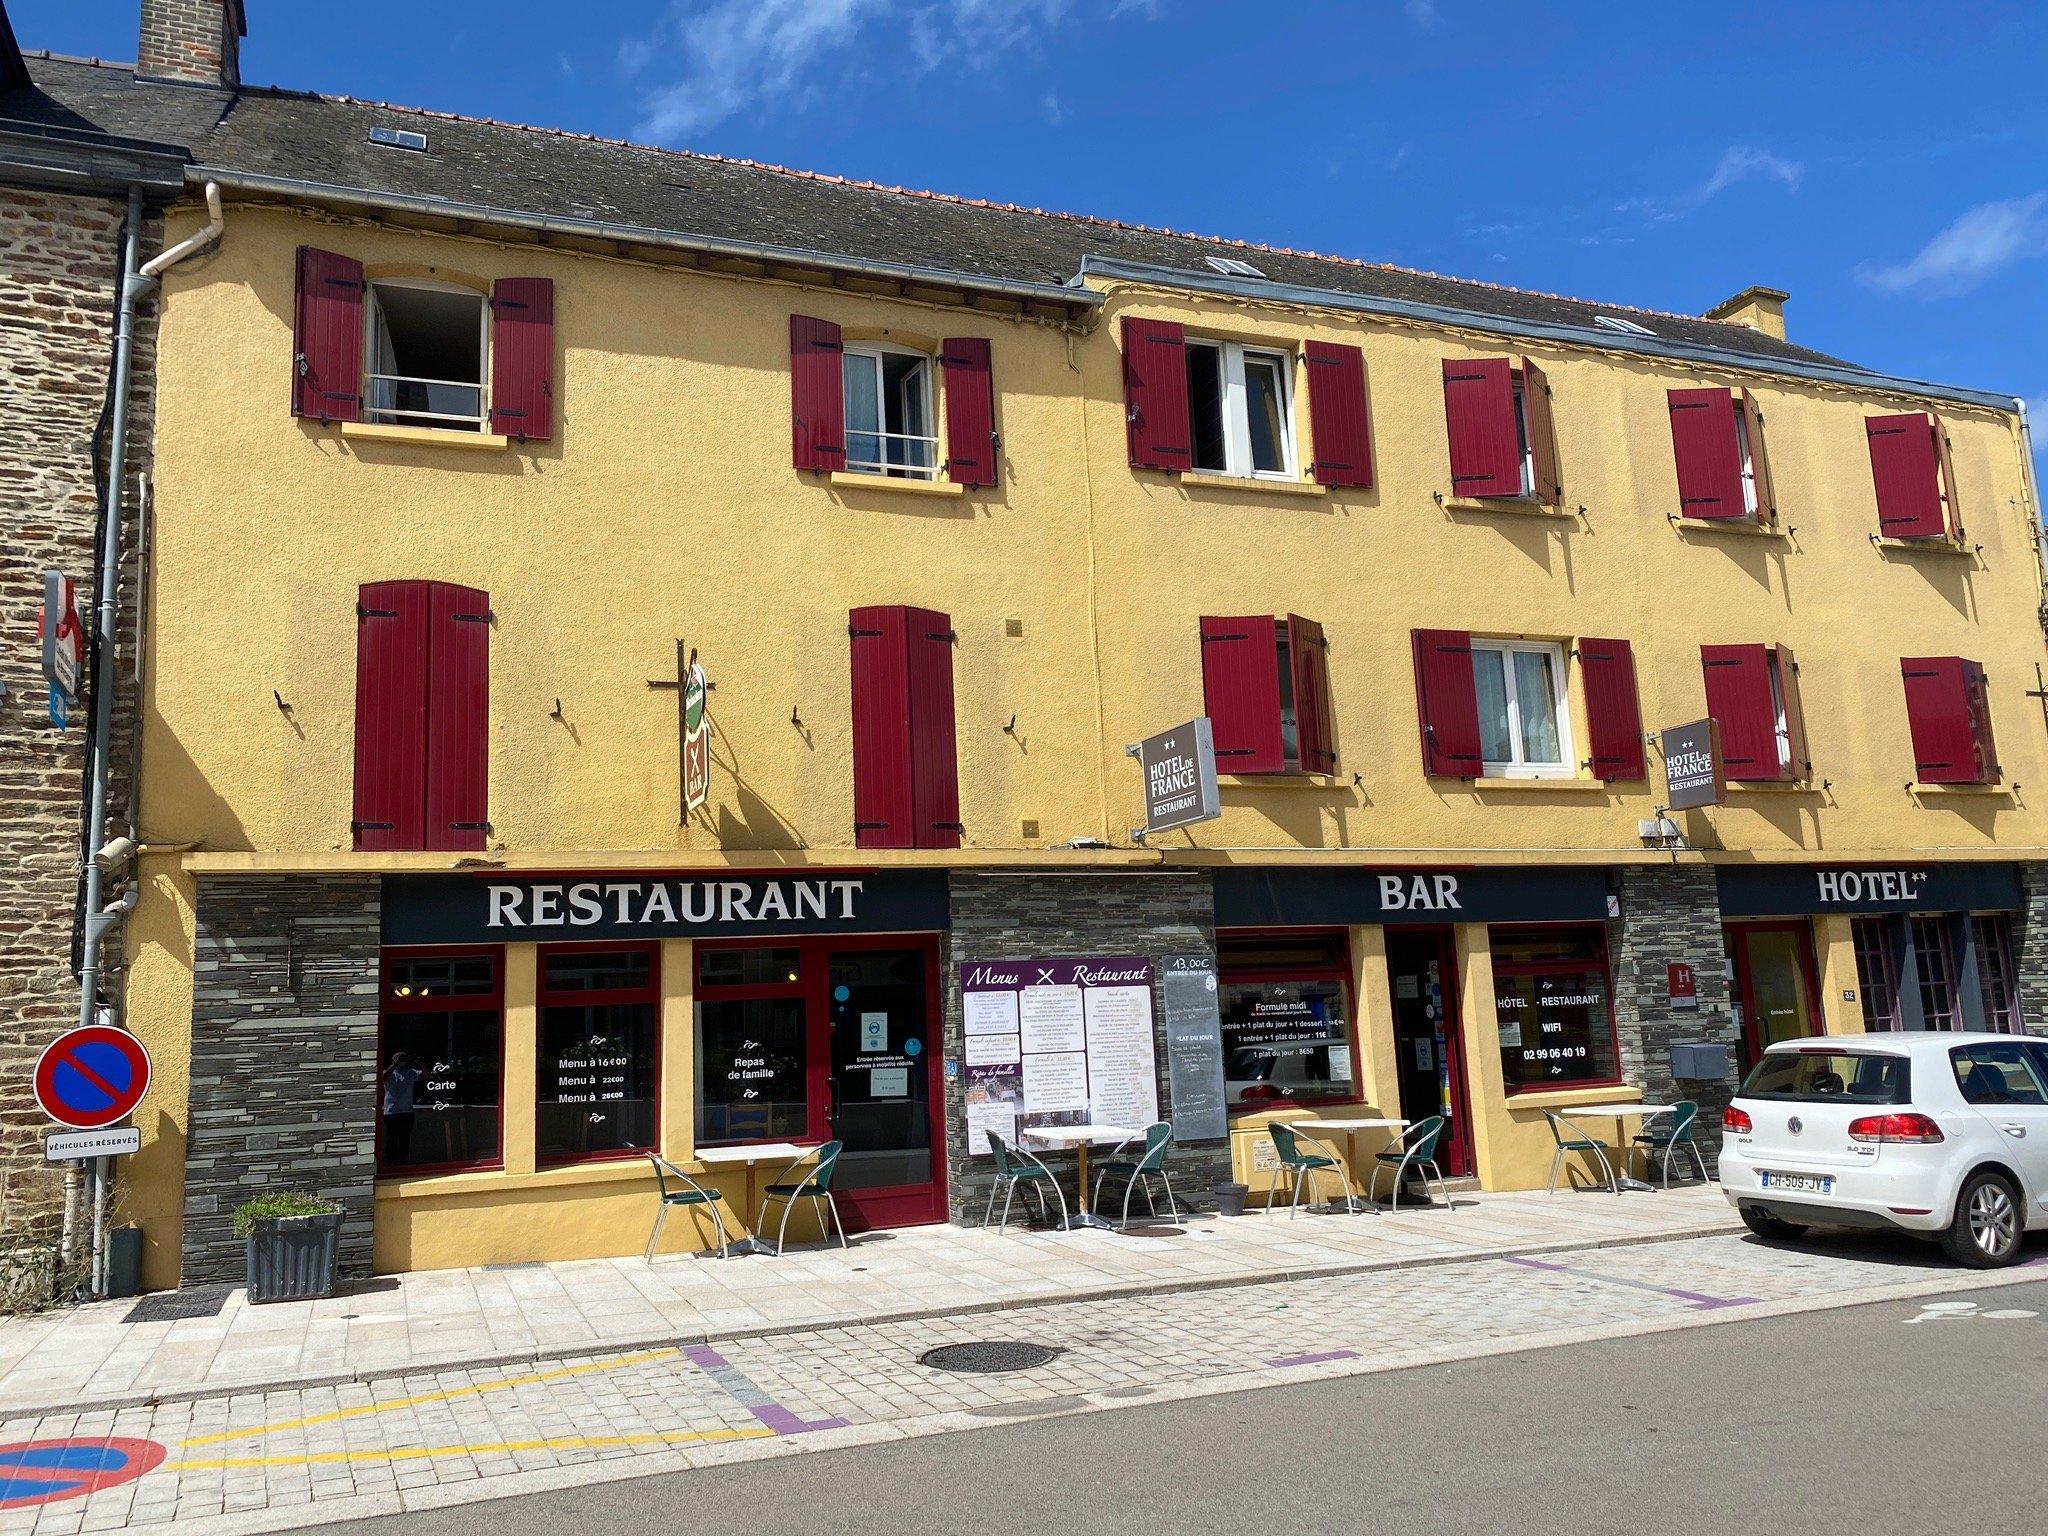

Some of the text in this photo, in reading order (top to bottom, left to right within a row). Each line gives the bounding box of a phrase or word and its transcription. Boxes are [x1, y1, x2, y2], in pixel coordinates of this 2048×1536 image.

[1666, 751, 1711, 768] HOTEL DE
[1150, 755, 1194, 781] HOTEL DE
[1667, 760, 1712, 778] FRANCE
[689, 774, 702, 796] BAR
[1151, 768, 1196, 798] FRANCE
[1670, 776, 1713, 792] RESTAURANT
[1154, 795, 1197, 817] RESTAURANT
[1377, 875, 1463, 909] BAR
[1816, 871, 1917, 901] HOTEL
[487, 880, 864, 927] RESTAURANT
[967, 965, 1148, 987] Menus Restaurant
[1678, 970, 1690, 982] H
[1497, 997, 1528, 1008] HÔTEL
[1541, 995, 1599, 1006] RESTAURANT
[1844, 991, 1854, 999] 32
[1255, 1001, 1307, 1011] Formule midi
[1253, 1021, 1265, 1029] plat
[1266, 1020, 1274, 1028] du
[1275, 1020, 1287, 1028] jour
[1542, 1022, 1562, 1032] WIFI
[1275, 1033, 1288, 1041] plat
[1289, 1032, 1297, 1040] du
[1297, 1032, 1310, 1041] jour
[1259, 1050, 1271, 1059] plat
[1272, 1049, 1280, 1057] du
[1281, 1049, 1294, 1057] jour
[1523, 1046, 1586, 1060] 02 99 06 40 19
[559, 1060, 587, 1068] Menu
[589, 1057, 596, 1067] à
[734, 1058, 765, 1068] Repas
[845, 1063, 871, 1071] personnes
[559, 1077, 587, 1086] Menu
[589, 1075, 596, 1085] à
[728, 1068, 774, 1080] de famille
[427, 1080, 456, 1091] Carte
[559, 1094, 587, 1103] Menu
[589, 1092, 596, 1101] à
[49, 1136, 137, 1151] VÉHICULES RÉSERVÉS
[1770, 1173, 1822, 1190] CH-509-JV
